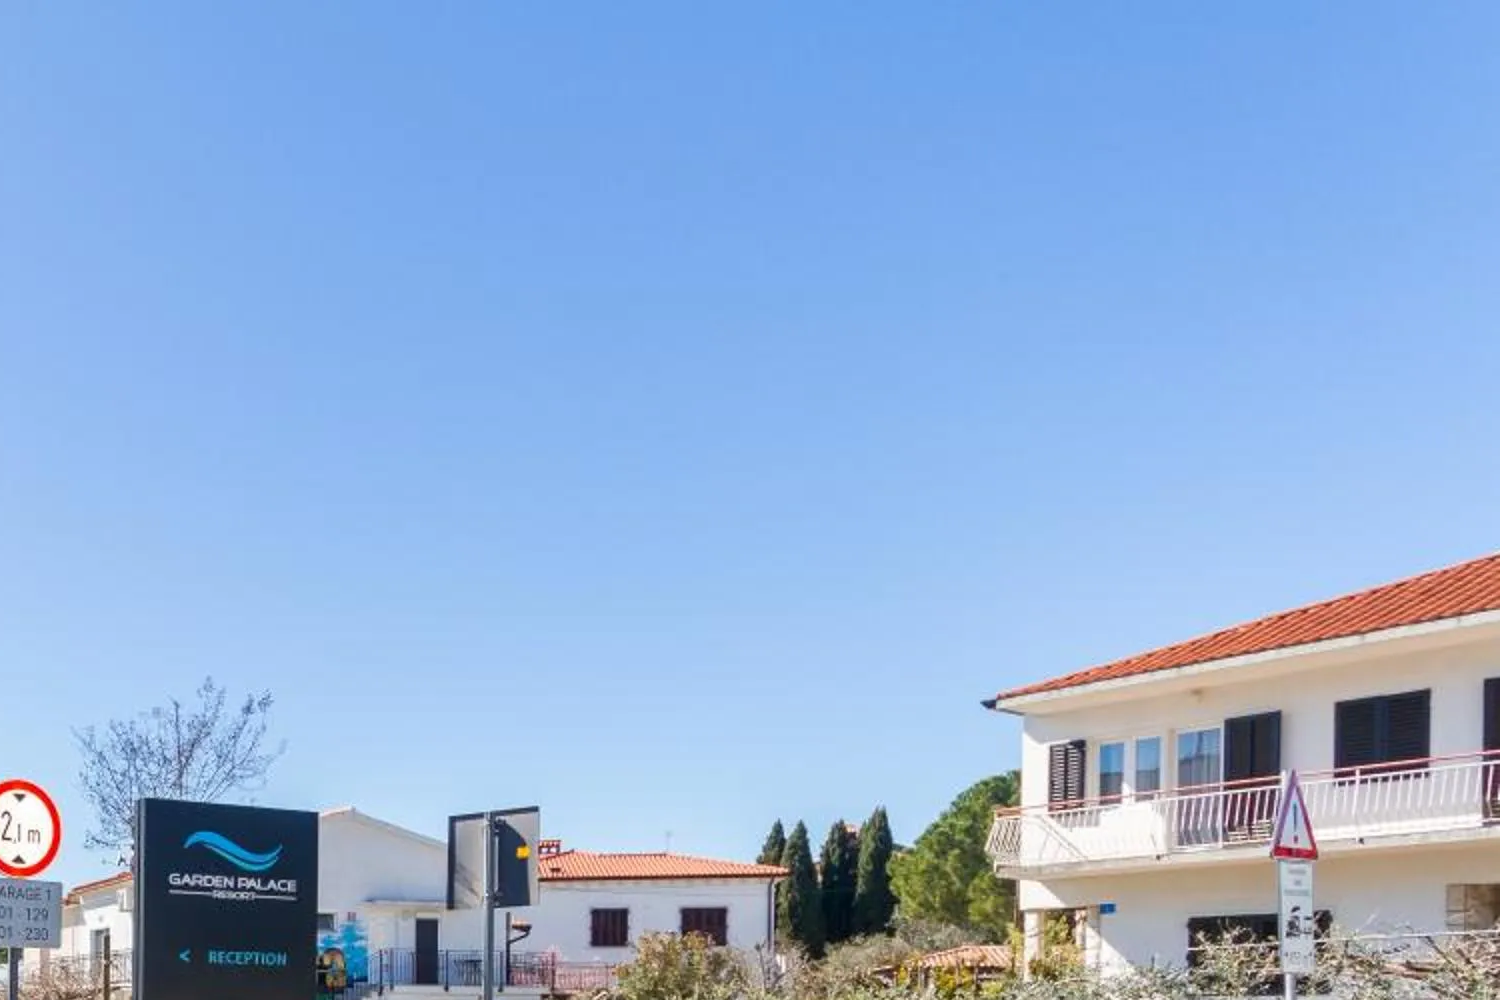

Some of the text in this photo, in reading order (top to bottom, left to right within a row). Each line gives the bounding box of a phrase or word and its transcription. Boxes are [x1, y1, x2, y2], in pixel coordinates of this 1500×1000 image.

[27, 829, 41, 844] m
[168, 873, 297, 892] GARDEN PALACE
[26, 907, 49, 921] 129
[208, 950, 287, 966] RECEPTION
